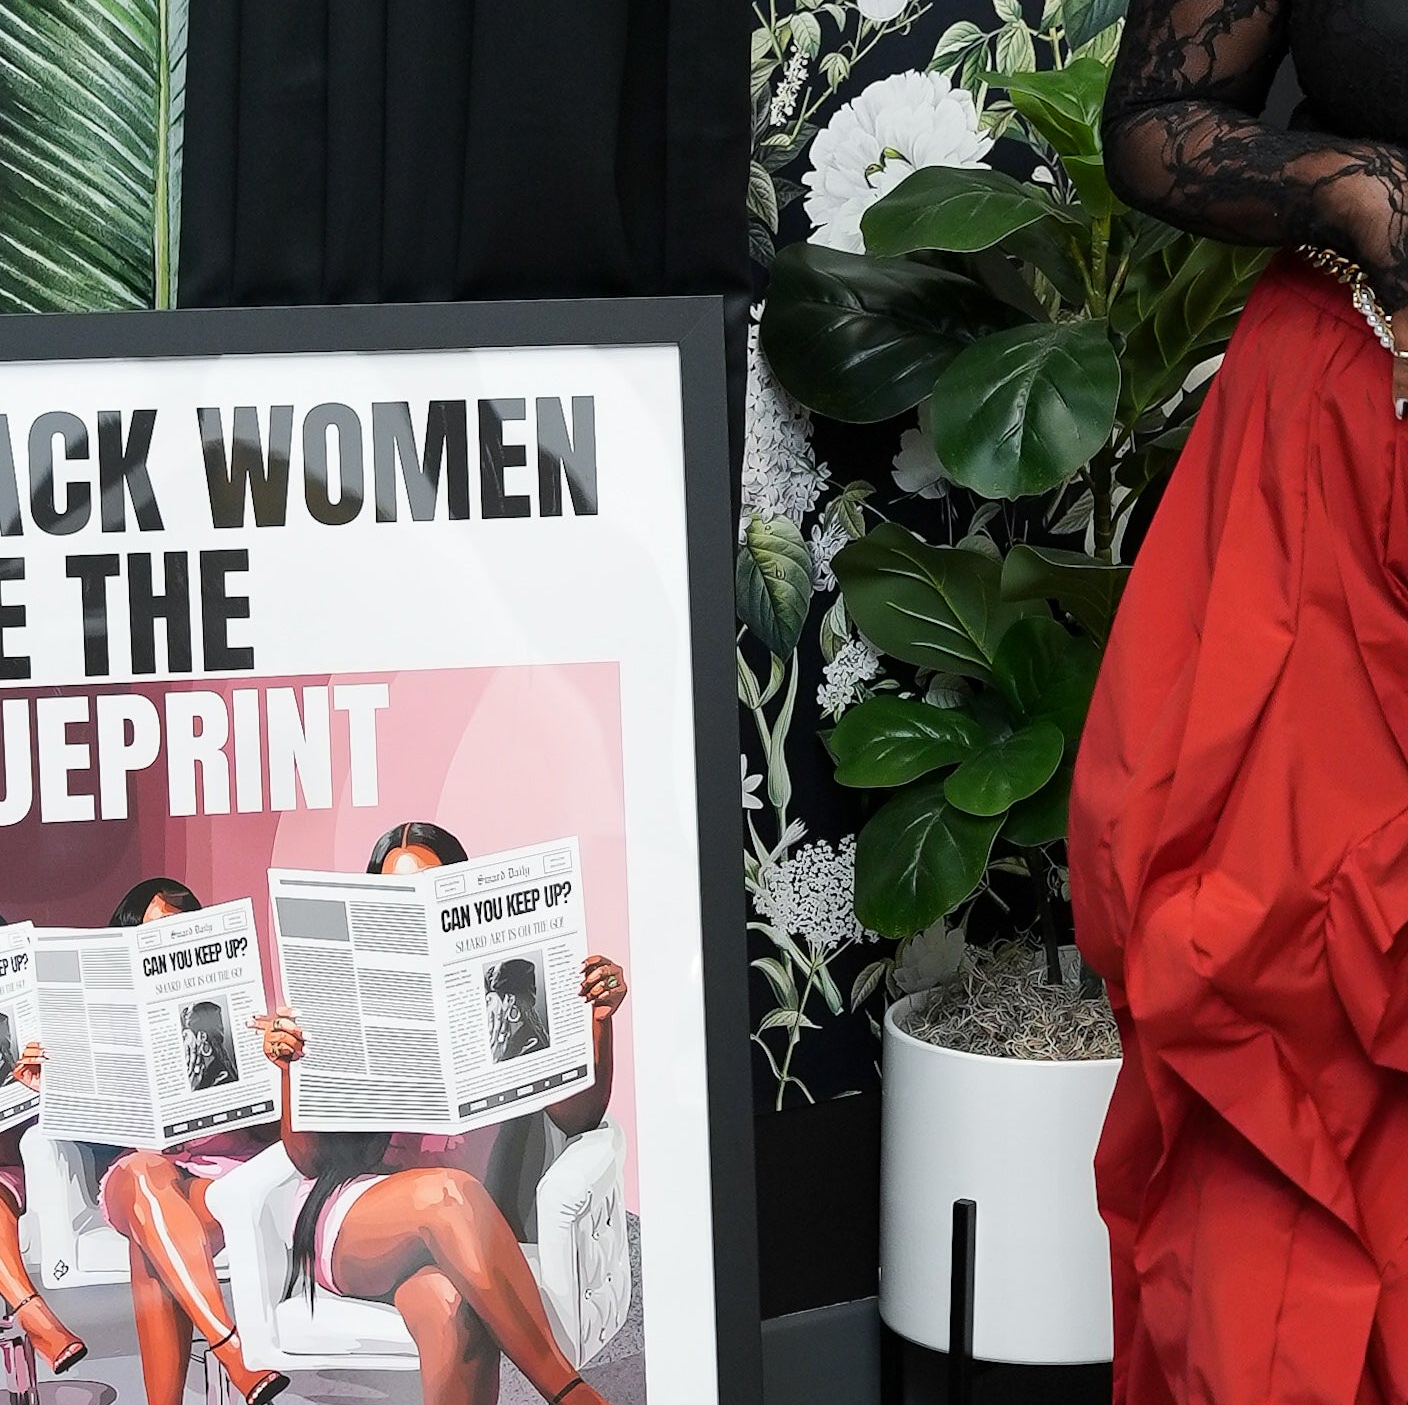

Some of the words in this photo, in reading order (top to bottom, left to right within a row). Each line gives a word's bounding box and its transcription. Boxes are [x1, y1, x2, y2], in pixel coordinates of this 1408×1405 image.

[197, 396, 598, 528] WOMEN
[66, 549, 254, 676] THE
[441, 904, 471, 933] CAN
[474, 897, 503, 925] YOU
[506, 888, 540, 917] KEEP
[544, 881, 572, 908] UP?
[490, 929, 506, 945] ART
[508, 926, 519, 941] IS
[533, 920, 547, 935] THE
[10, 953, 28, 973] UP?
[143, 954, 168, 977] CAN
[169, 949, 193, 971] YOU
[195, 942, 222, 966] KEEP
[225, 937, 248, 959] UP?
